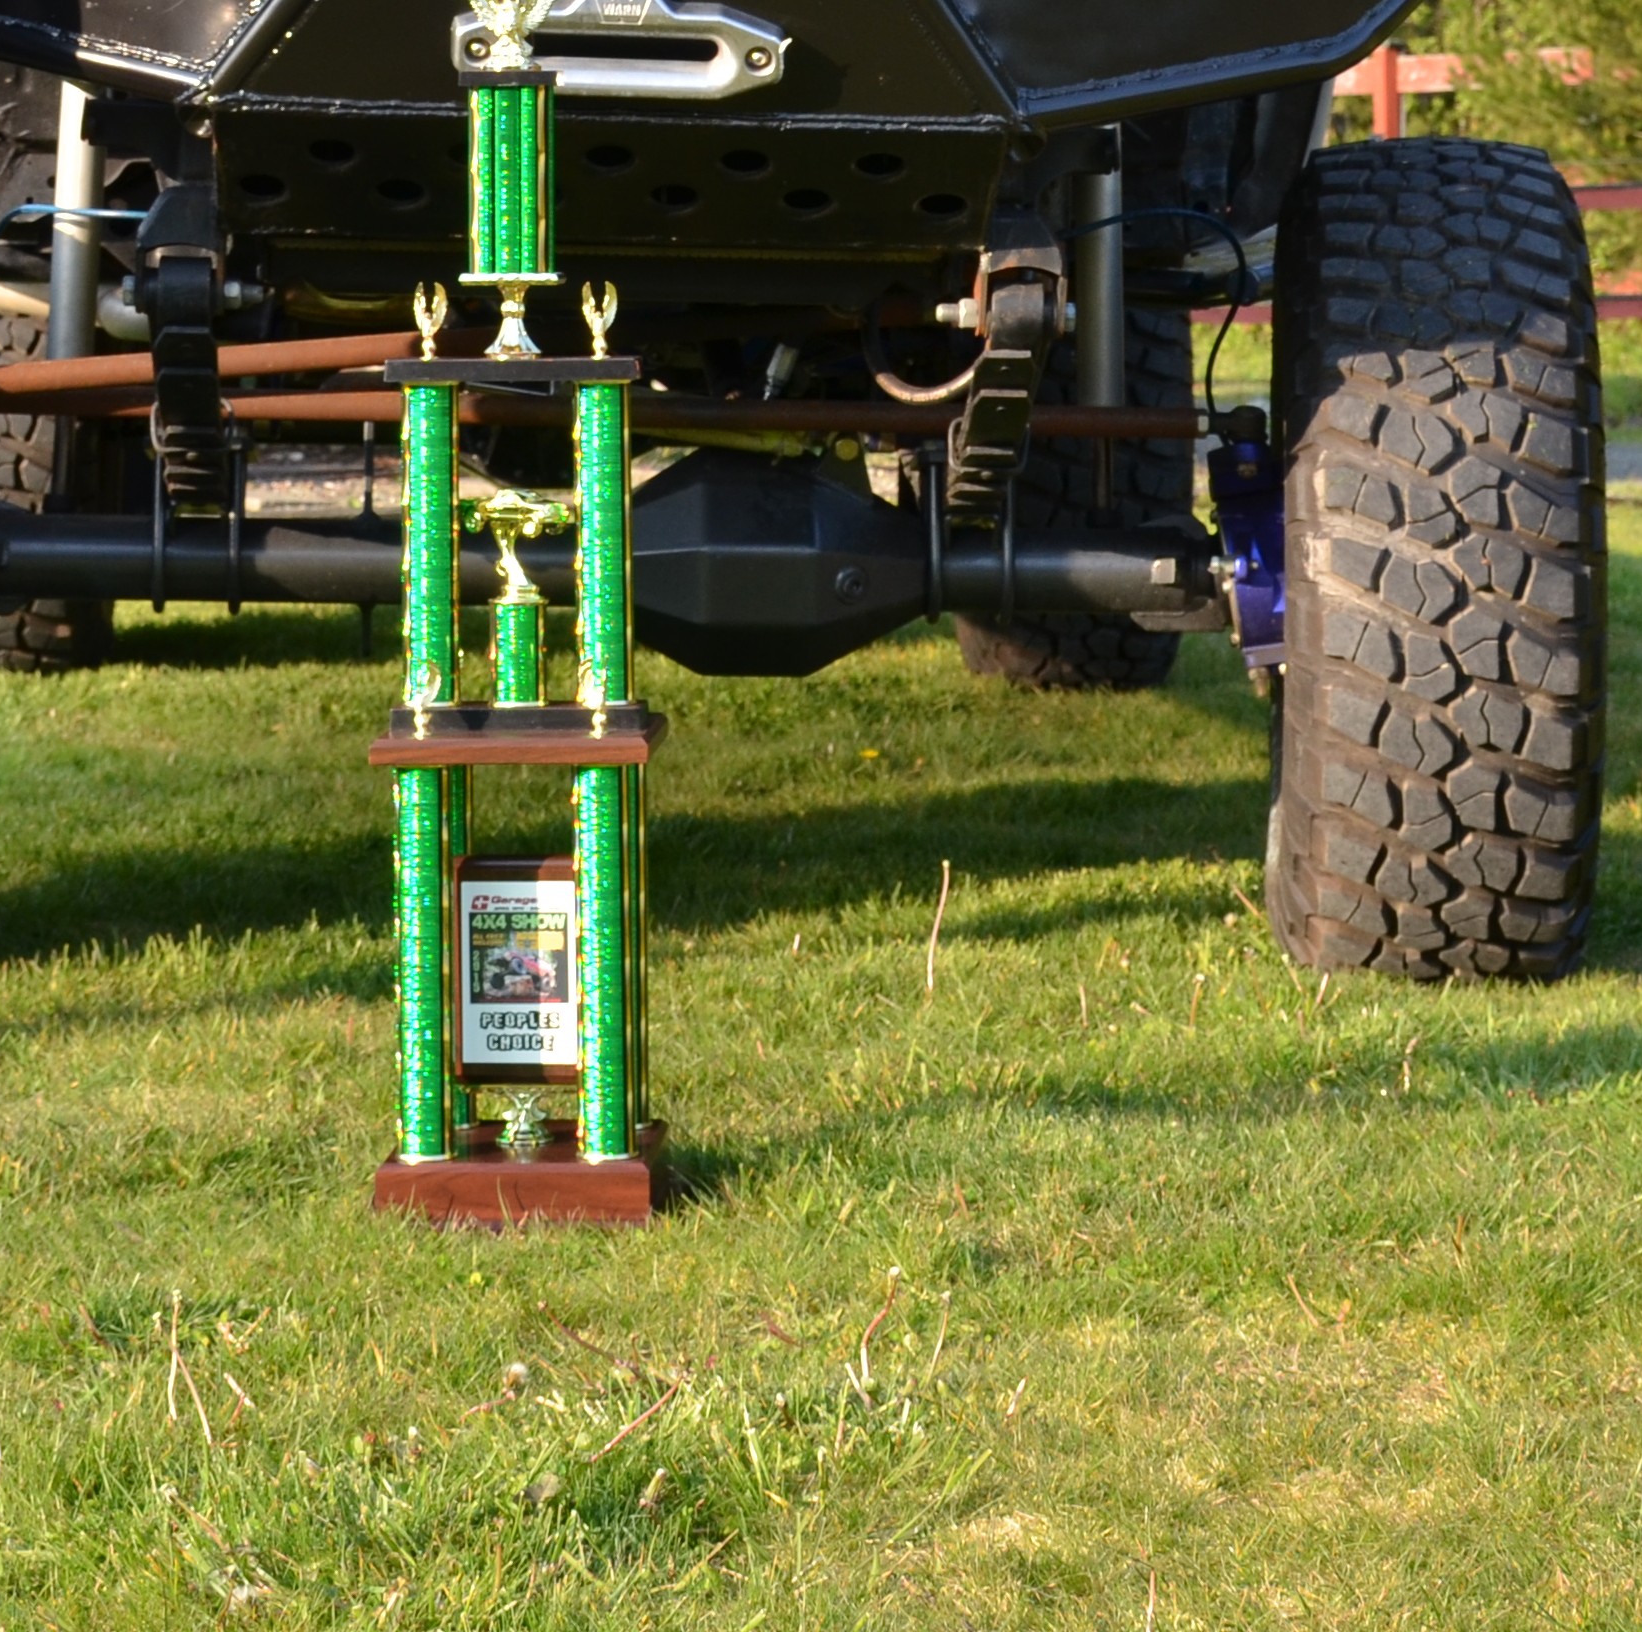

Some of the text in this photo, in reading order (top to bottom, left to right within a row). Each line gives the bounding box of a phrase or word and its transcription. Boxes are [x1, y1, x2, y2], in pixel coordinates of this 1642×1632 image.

[602, 2, 642, 16] WARN
[491, 895, 538, 905] Garage
[471, 913, 567, 930] 4X4 SHOW
[479, 1011, 560, 1030] PEOPLES
[486, 1033, 554, 1051] CHOICE
